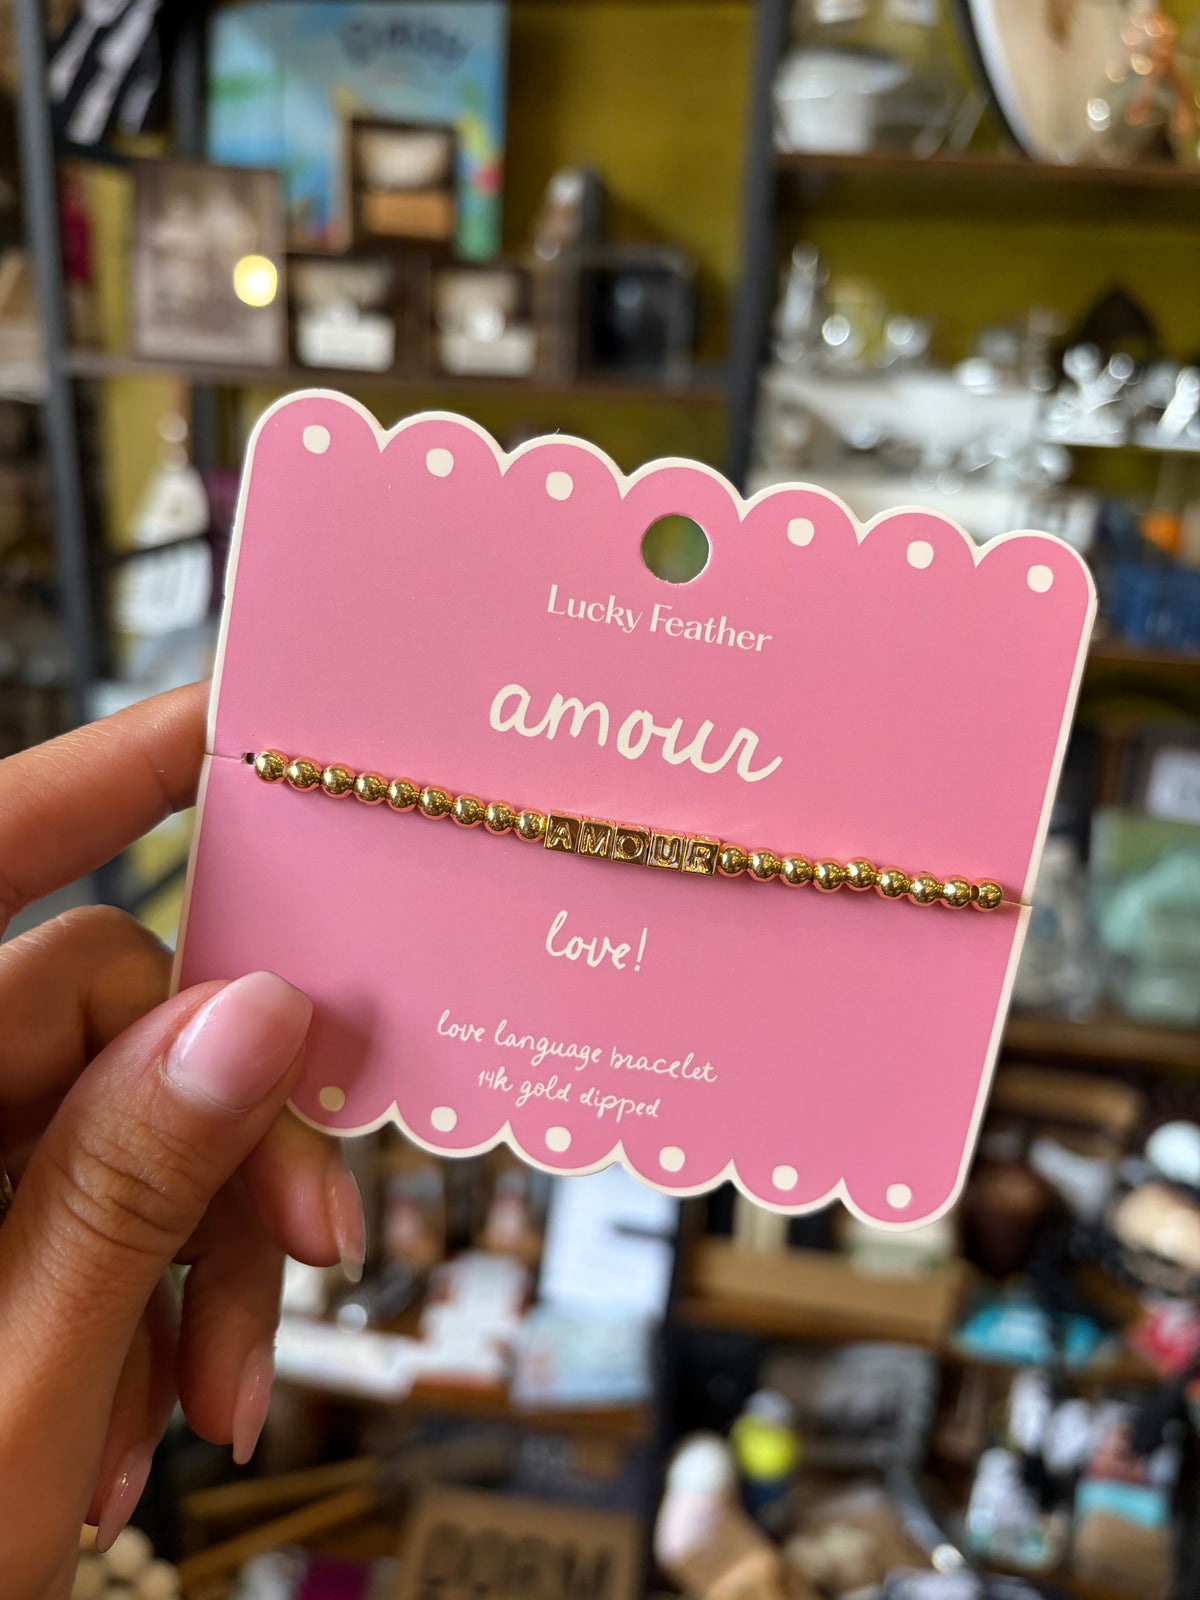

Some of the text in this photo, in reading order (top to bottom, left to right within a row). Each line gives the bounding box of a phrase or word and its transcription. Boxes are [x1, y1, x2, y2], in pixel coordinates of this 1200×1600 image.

[546, 583, 773, 652] Lucky Feather
[489, 683, 783, 783] amour
[546, 818, 712, 876] AMOUR
[545, 909, 648, 972] love!
[436, 1009, 718, 1083] love language bracelet
[477, 1066, 661, 1123] 14k gold dipped
